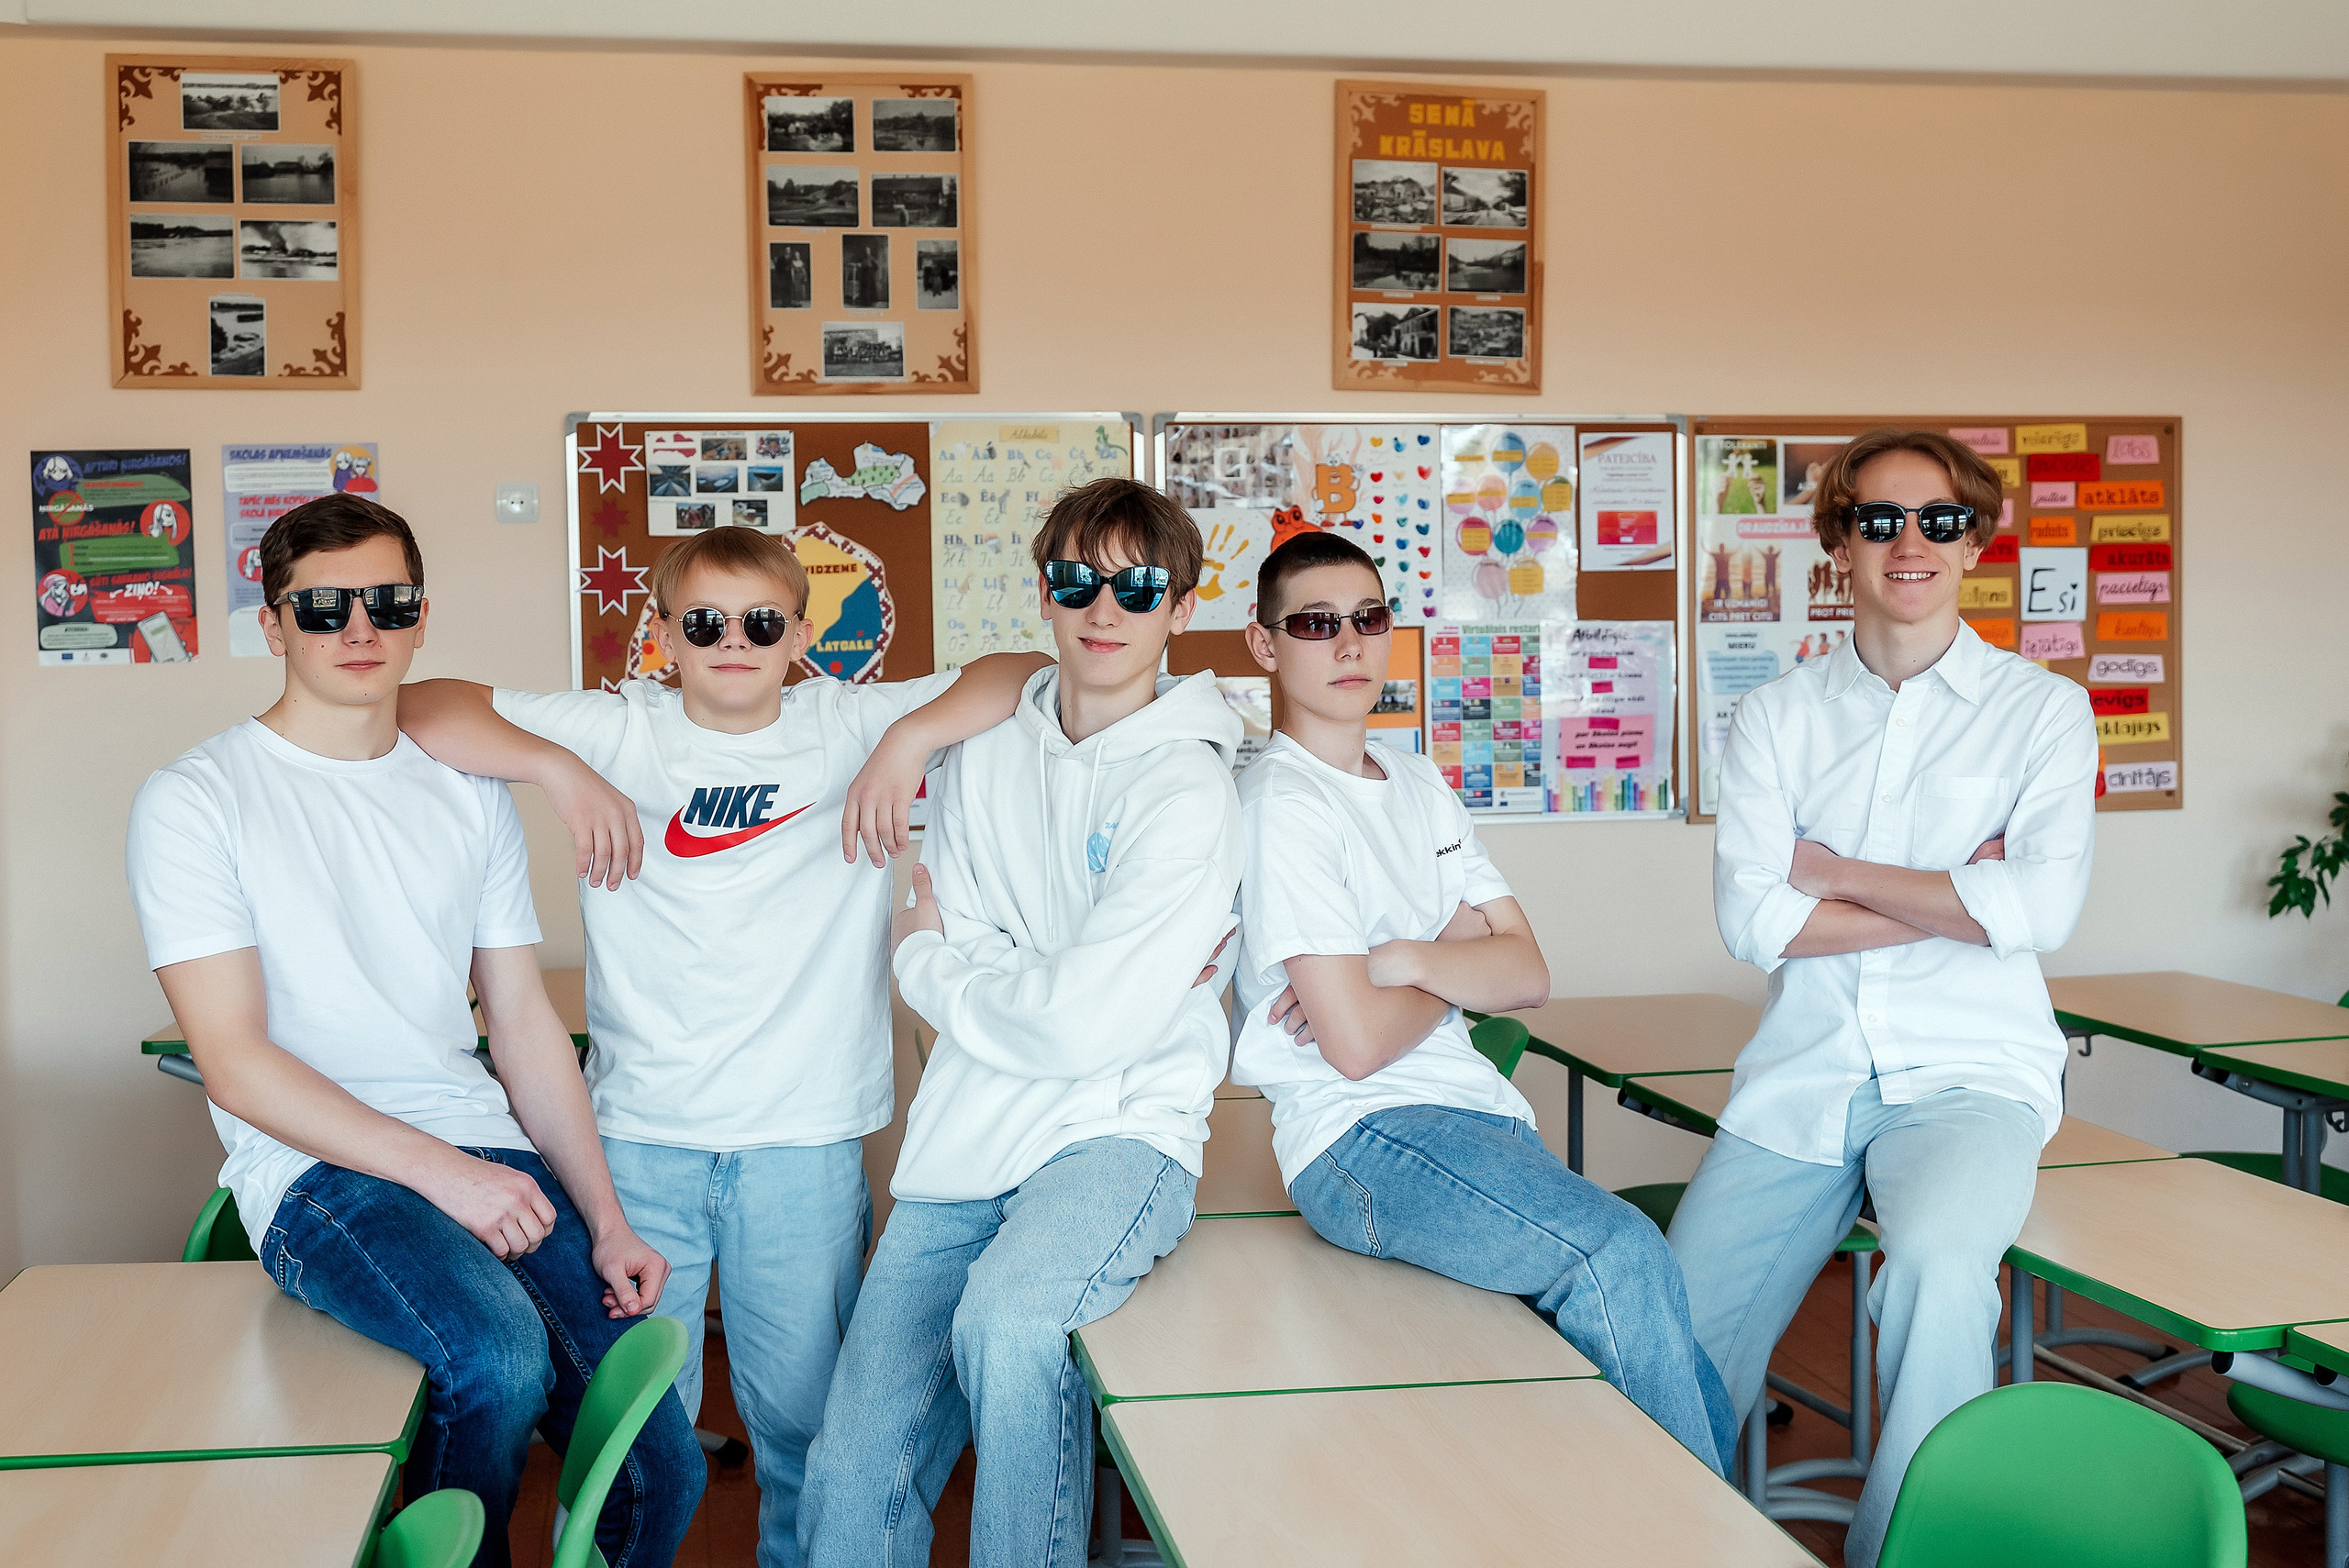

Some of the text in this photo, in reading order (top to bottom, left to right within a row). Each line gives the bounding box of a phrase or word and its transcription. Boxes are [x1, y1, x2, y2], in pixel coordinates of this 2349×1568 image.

[1408, 99, 1475, 128] SENĀ
[1379, 129, 1506, 161] KRĀSLAVA
[2084, 487, 2159, 505] atklāts
[2029, 567, 2078, 613] Esi
[2096, 659, 2157, 677] godīgs
[684, 784, 780, 828] NIKE
